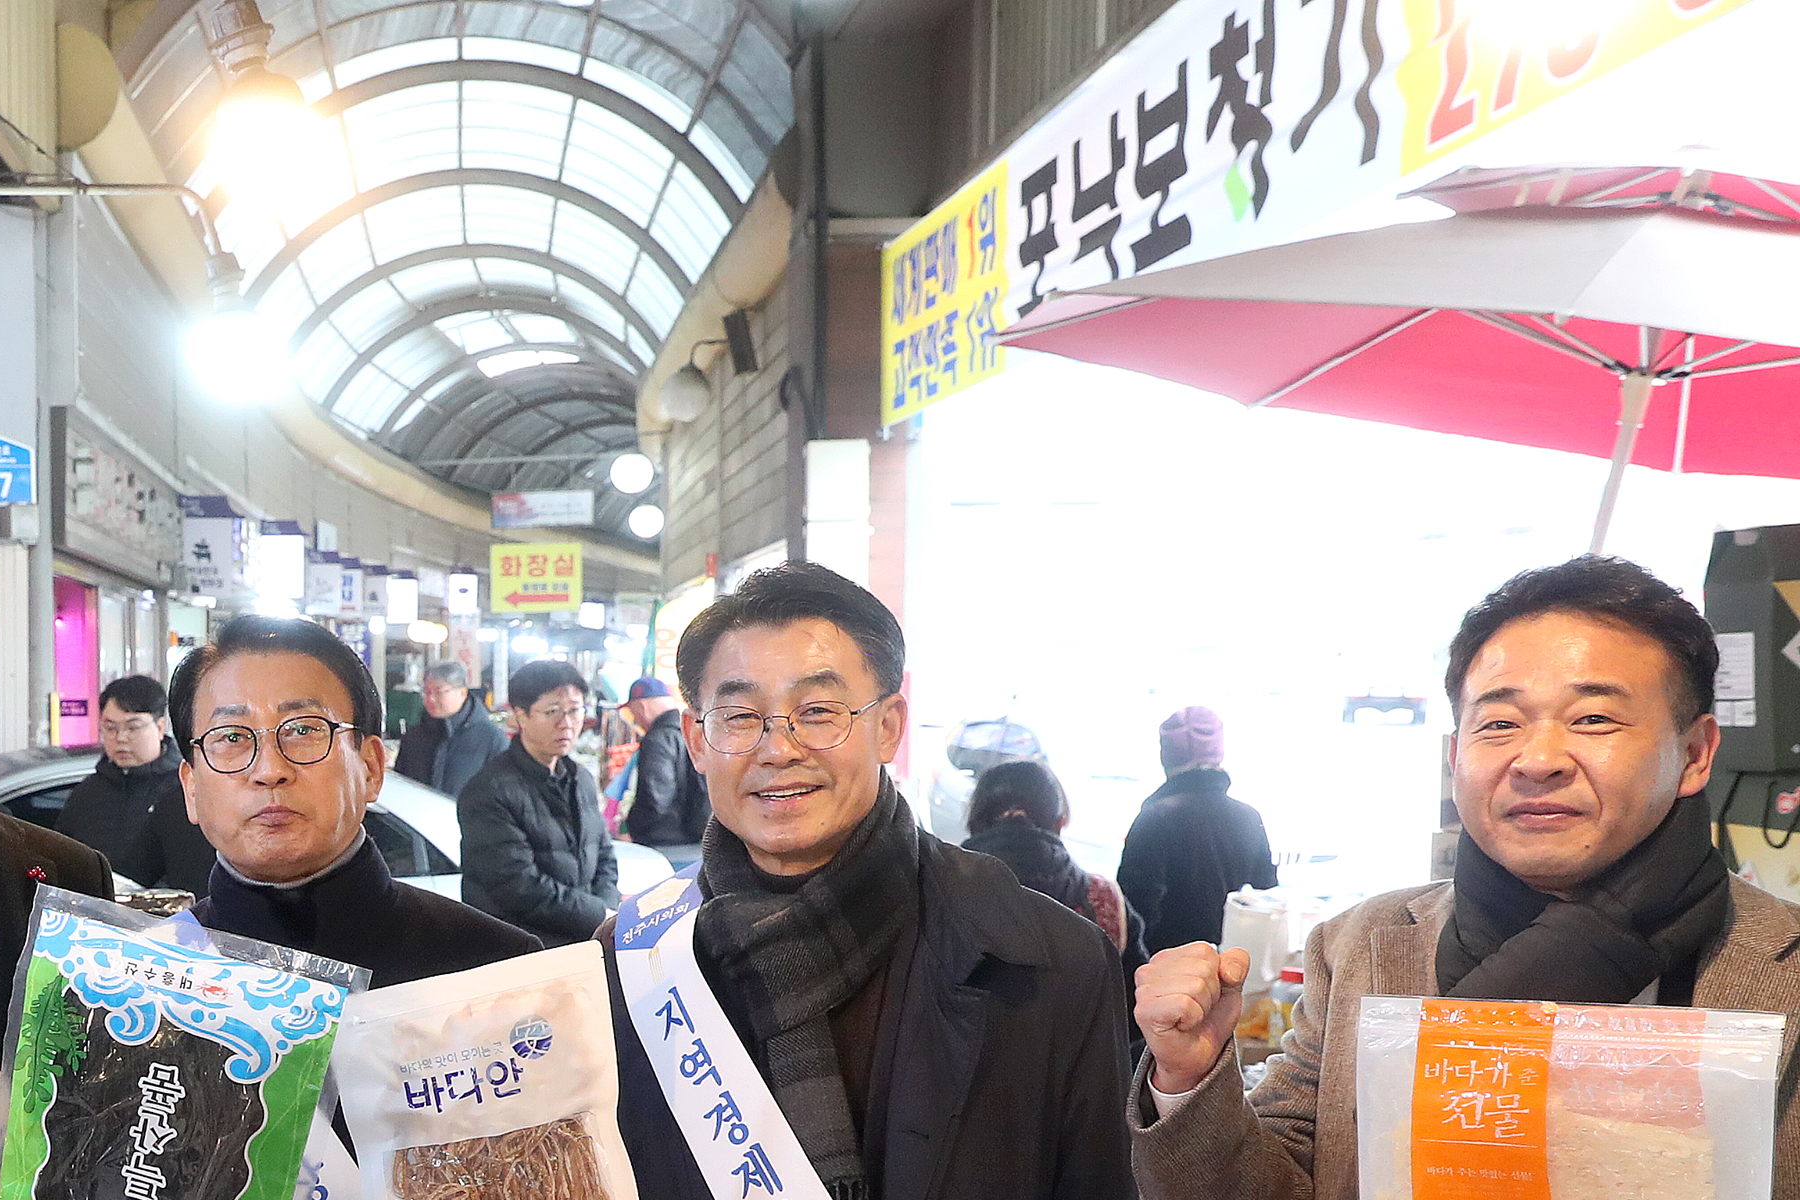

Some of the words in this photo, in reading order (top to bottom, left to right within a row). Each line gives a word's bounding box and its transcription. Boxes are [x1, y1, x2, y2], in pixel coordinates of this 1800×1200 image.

[891, 213, 959, 326] 세계판매
[966, 186, 997, 281] 1위
[499, 554, 576, 578] 화장실
[620, 901, 691, 946] 전주시의회
[122, 961, 199, 991] 대흥수산
[399, 1057, 434, 1075] 바다의
[435, 1052, 459, 1068] 맛이
[460, 1045, 493, 1063] 모이는
[493, 1040, 505, 1055] 곳
[1423, 1056, 1513, 1089] 바다가
[1518, 1066, 1540, 1087] 준
[403, 1056, 525, 1114] 바다안
[1426, 1165, 1454, 1177] 바다가
[1457, 1167, 1477, 1178] 주는
